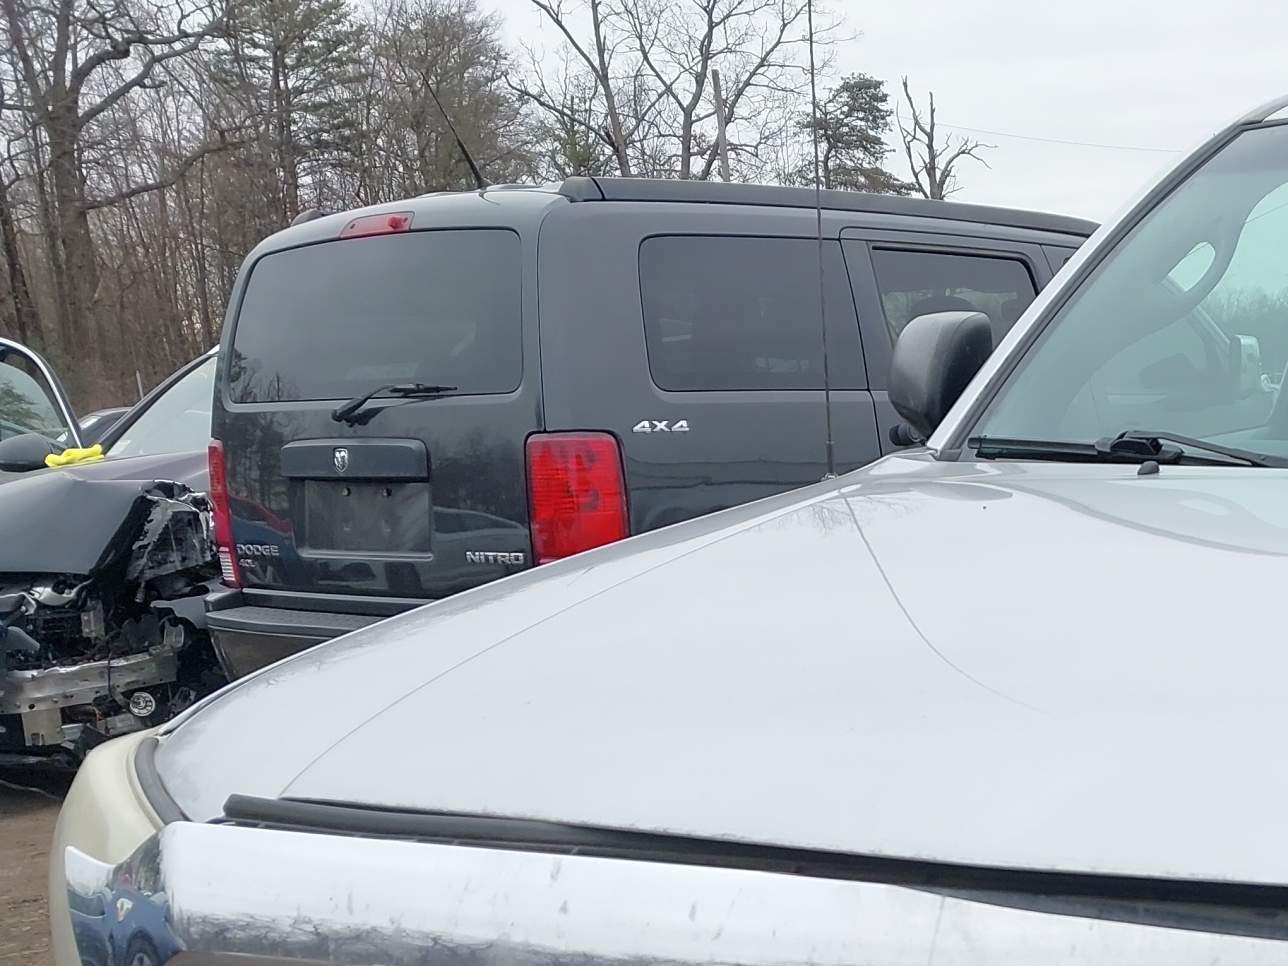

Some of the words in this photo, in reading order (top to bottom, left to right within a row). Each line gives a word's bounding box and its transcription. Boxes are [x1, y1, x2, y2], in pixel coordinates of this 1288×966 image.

[632, 420, 690, 432] 4X4
[236, 543, 280, 556] DODGE
[465, 551, 524, 565] NITRO
